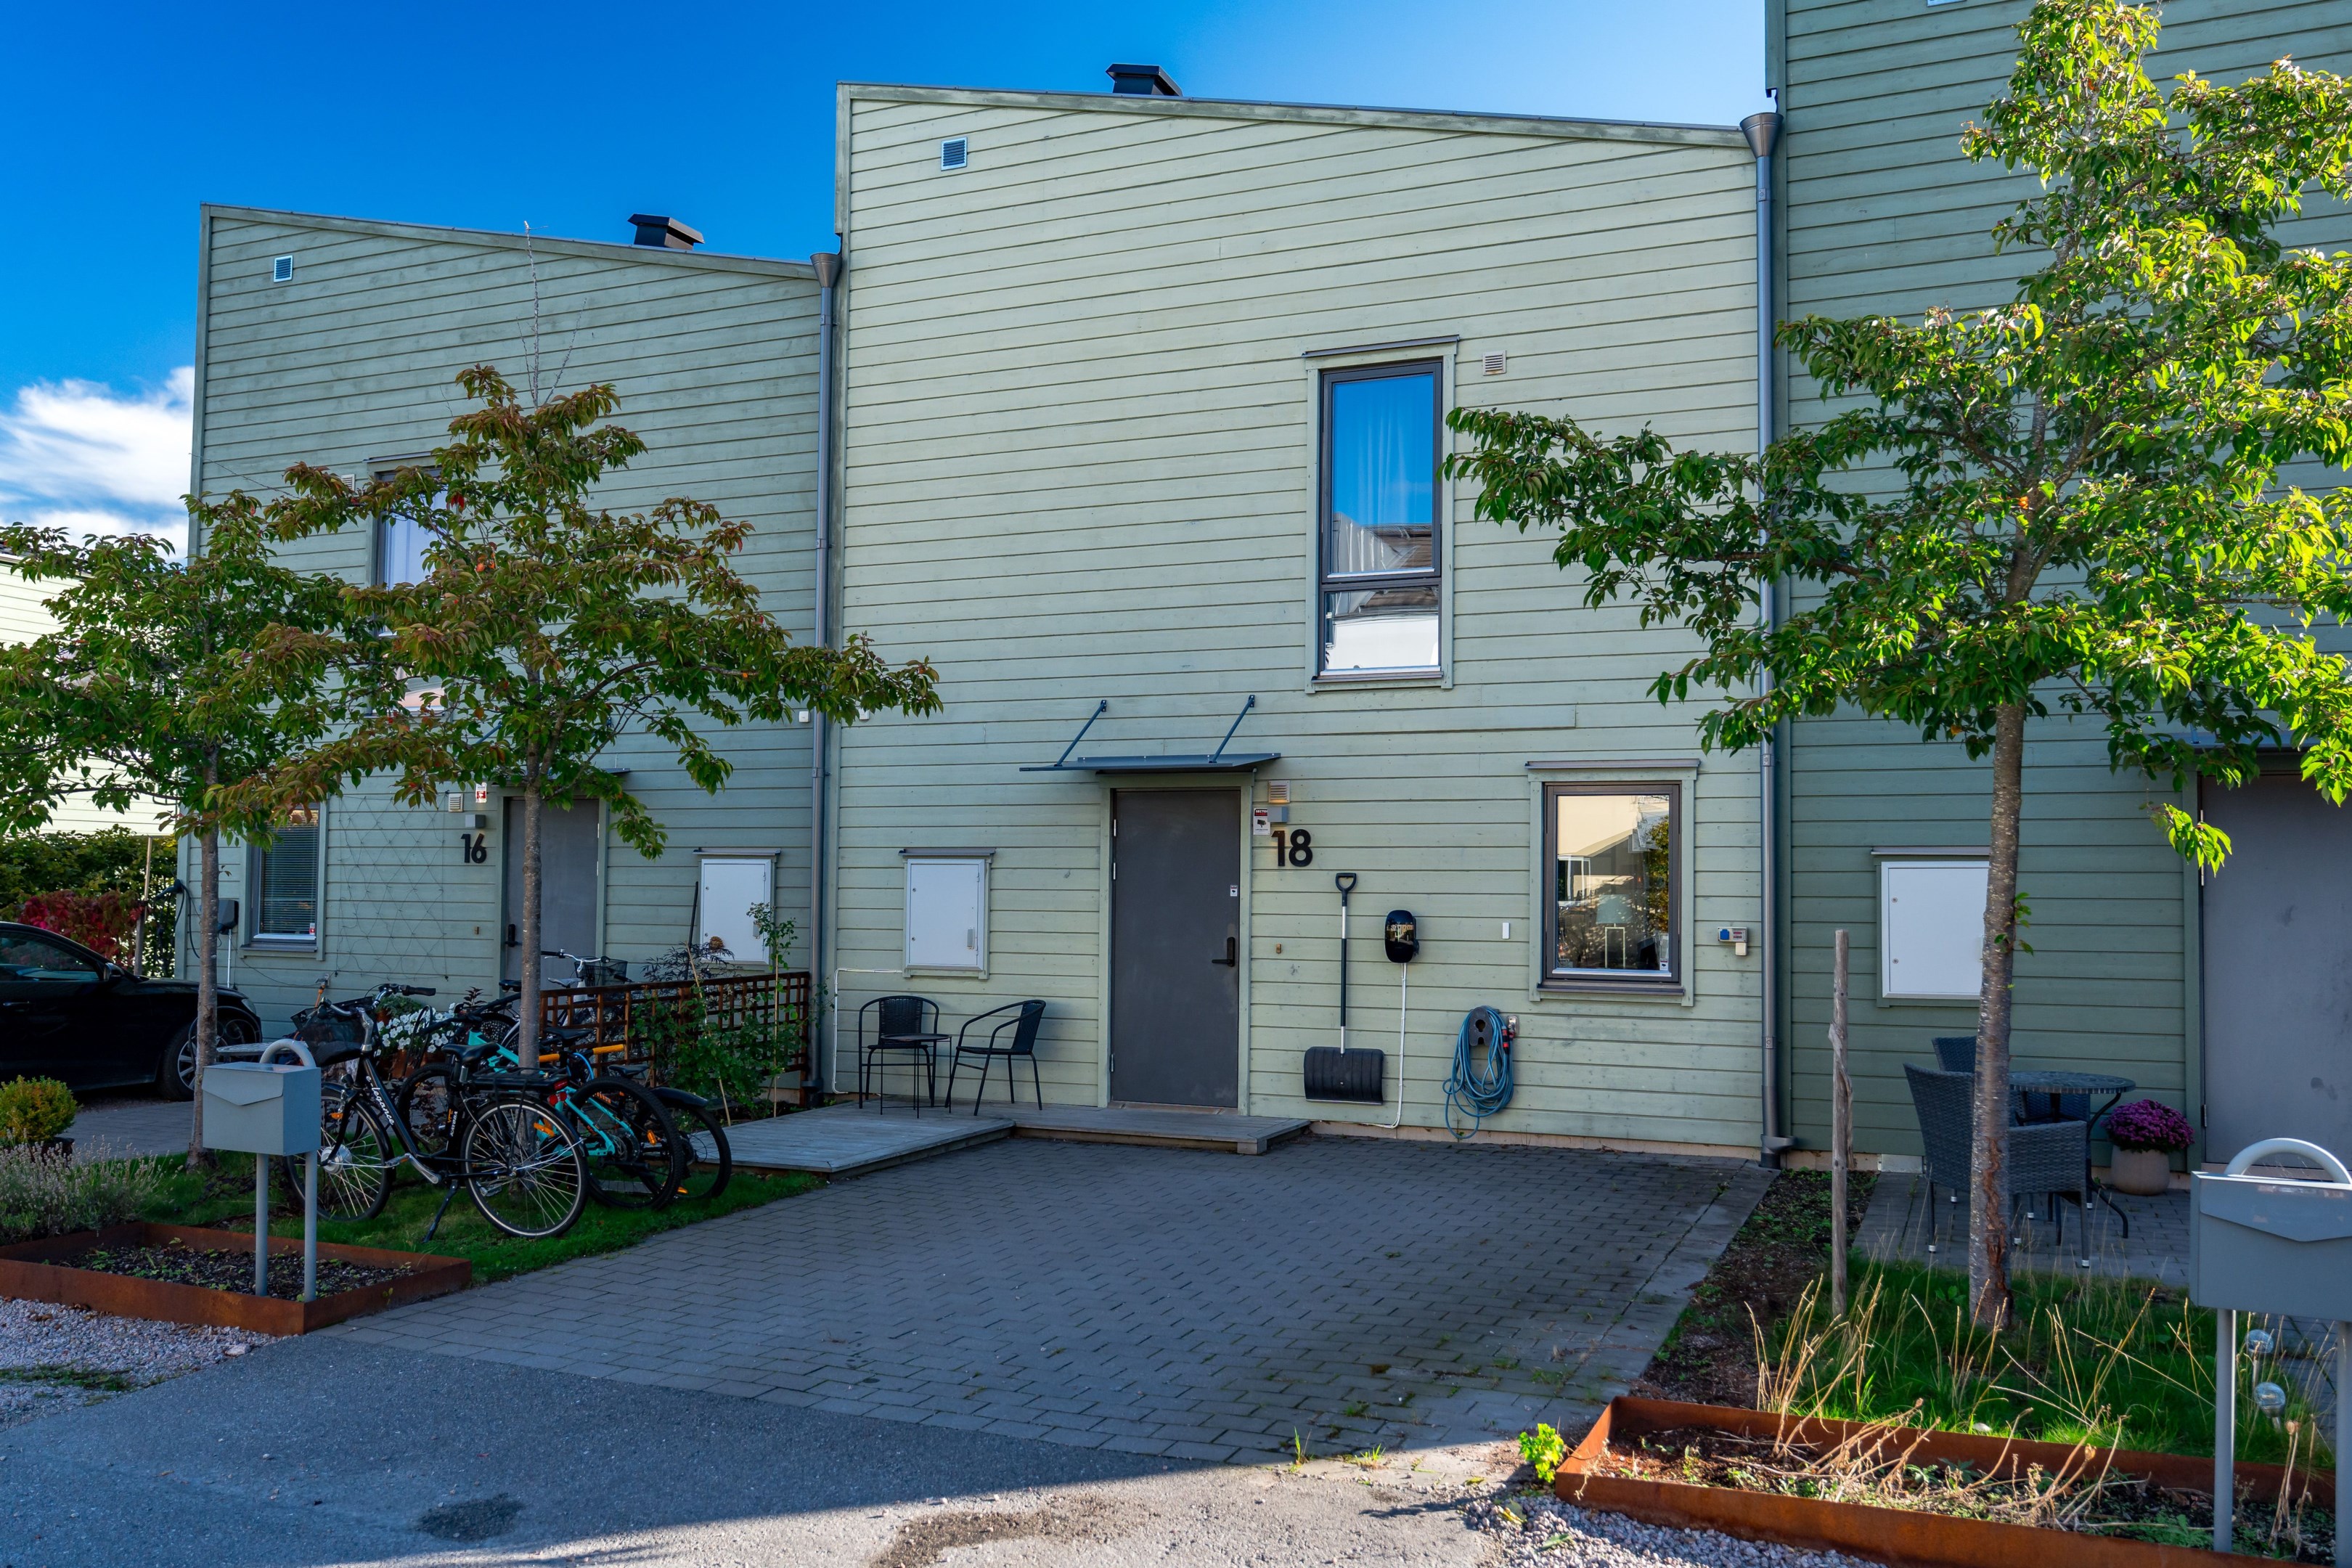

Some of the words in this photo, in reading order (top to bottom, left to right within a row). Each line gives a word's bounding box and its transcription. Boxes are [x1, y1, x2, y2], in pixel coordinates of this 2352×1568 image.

[460, 833, 487, 864] 16
[1271, 829, 1313, 867] 18
[366, 1076, 394, 1125] e-legance
